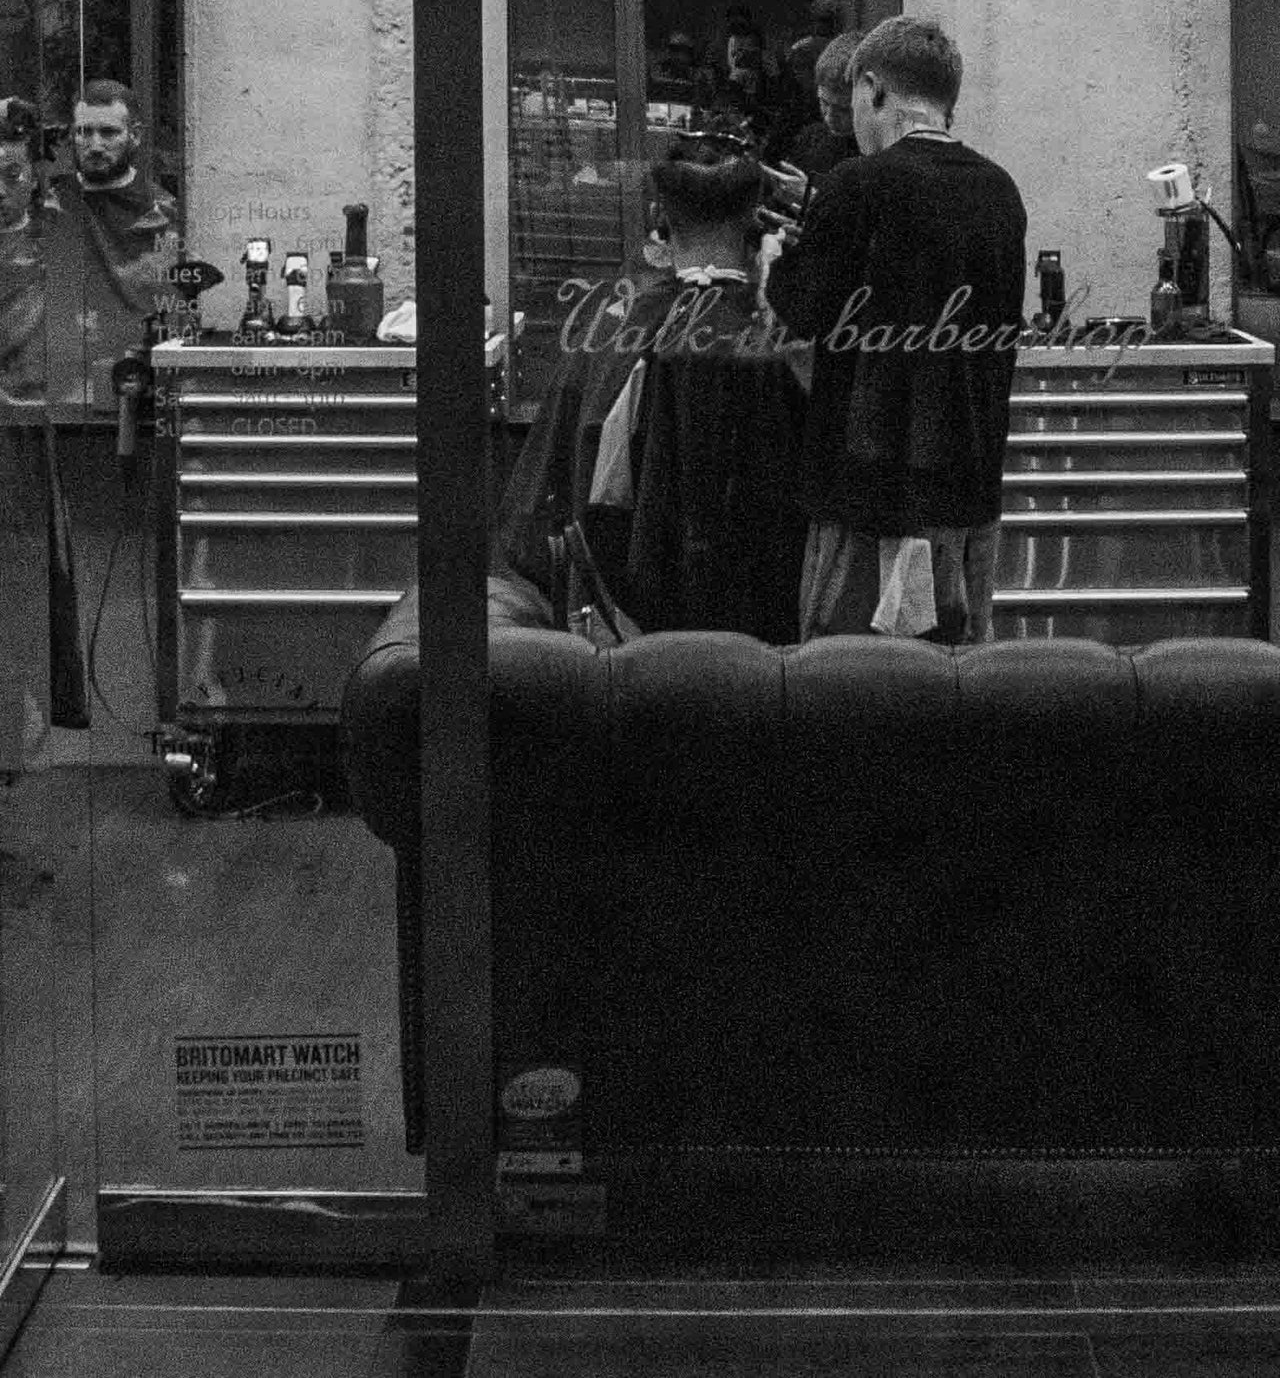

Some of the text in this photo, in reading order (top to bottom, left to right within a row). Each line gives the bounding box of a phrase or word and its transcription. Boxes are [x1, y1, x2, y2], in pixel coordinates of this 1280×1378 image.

[247, 201, 312, 221] Hours
[155, 265, 202, 284] Tues
[556, 277, 1157, 383] Walk-in barbershop
[231, 417, 318, 437] CLOSED
[176, 1043, 360, 1068] BRITOMART WATCH
[176, 1069, 229, 1084] KEEPING
